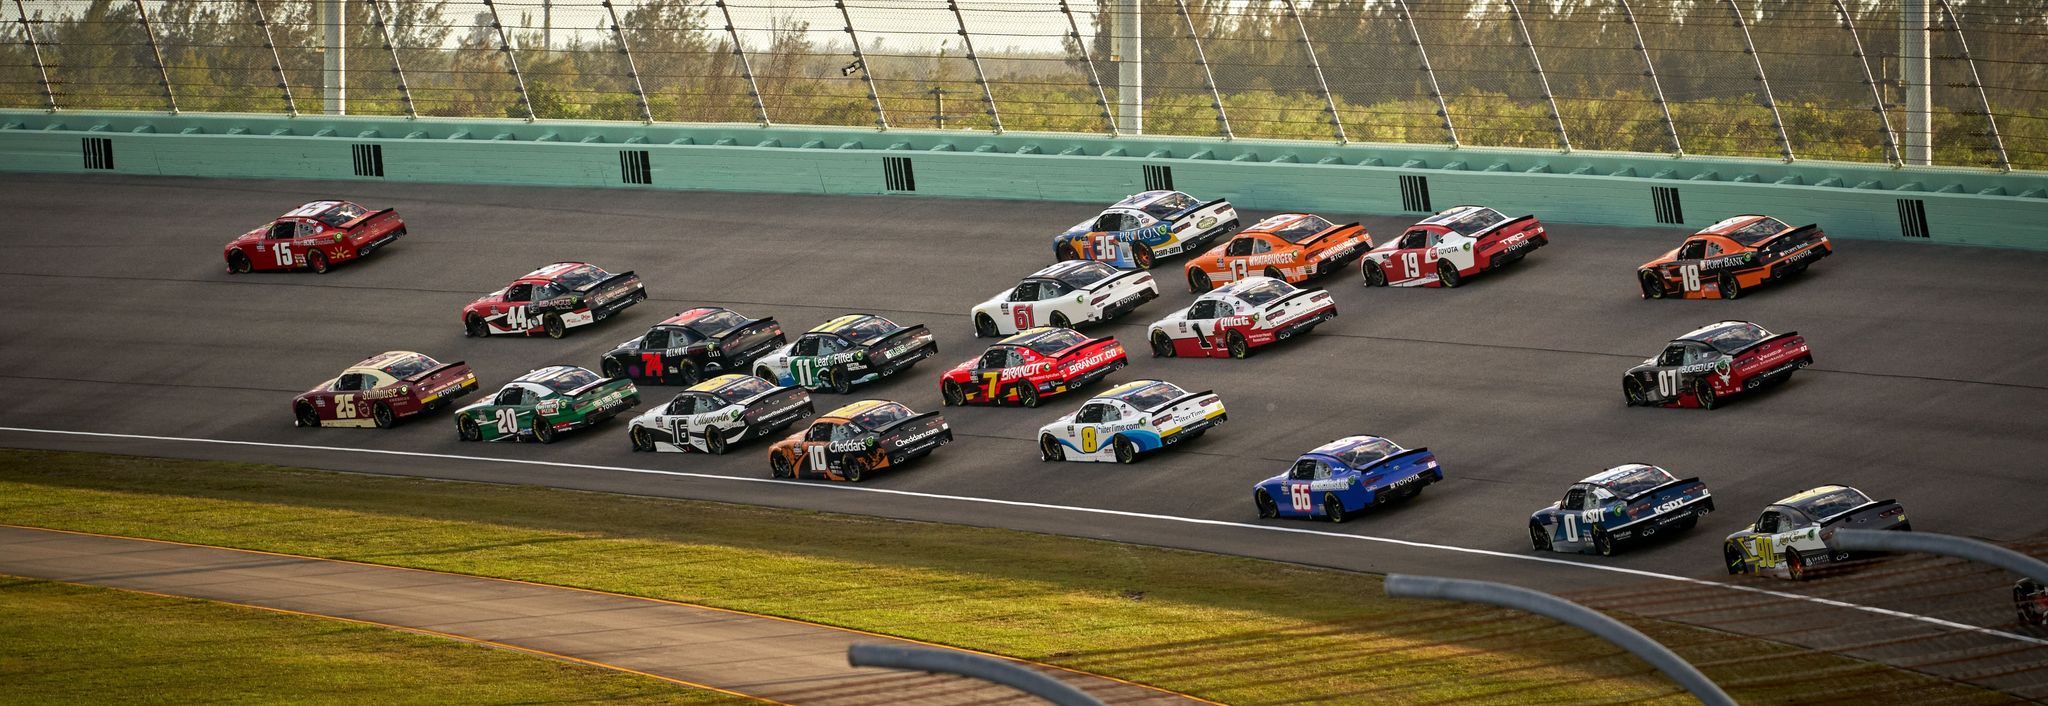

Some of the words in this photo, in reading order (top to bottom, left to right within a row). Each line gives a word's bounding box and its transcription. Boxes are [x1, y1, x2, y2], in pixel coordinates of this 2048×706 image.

[1096, 235, 1115, 260] 36
[1318, 236, 1359, 259] WHATABURGER
[1438, 245, 1459, 255] TOYOTA
[1499, 232, 1525, 245] TRD
[1507, 239, 1530, 252] TOYOTA
[272, 242, 293, 266] 15
[1154, 246, 1181, 257] can-am
[1249, 252, 1294, 266] WHATABURGER
[1334, 247, 1356, 260] TOYOTA
[1724, 256, 1745, 268] BANK
[1789, 249, 1812, 262] TOYOTA
[1229, 259, 1248, 281] 13
[1401, 253, 1420, 278] 19
[1680, 265, 1701, 292] 18
[1120, 293, 1141, 307] TOYOTA
[506, 306, 528, 330] 44
[1013, 304, 1035, 331] 61
[1192, 322, 1213, 350] 1
[666, 346, 689, 358] BELMONT
[1069, 348, 1117, 375] BRANDT.CO
[642, 352, 663, 377] 74
[796, 359, 813, 386] 11
[1001, 362, 1045, 381] BRANDT
[1681, 364, 1703, 374] BUCKED
[1702, 362, 1715, 372] UP
[442, 383, 462, 396] TOYOTA
[982, 371, 998, 399] 7
[1658, 370, 1677, 398] 07
[334, 394, 357, 418] 26
[602, 399, 624, 411] TOYOTA
[495, 408, 518, 434] 20
[669, 417, 691, 445] 16
[1081, 426, 1098, 454] 8
[807, 445, 827, 471] 10
[1394, 473, 1420, 488] TOYOTA
[1290, 483, 1312, 513] 66
[1653, 497, 1684, 515] KSDT
[1564, 513, 1579, 542] 0
[1582, 507, 1608, 524] KSDT
[1755, 535, 1775, 568] 90
